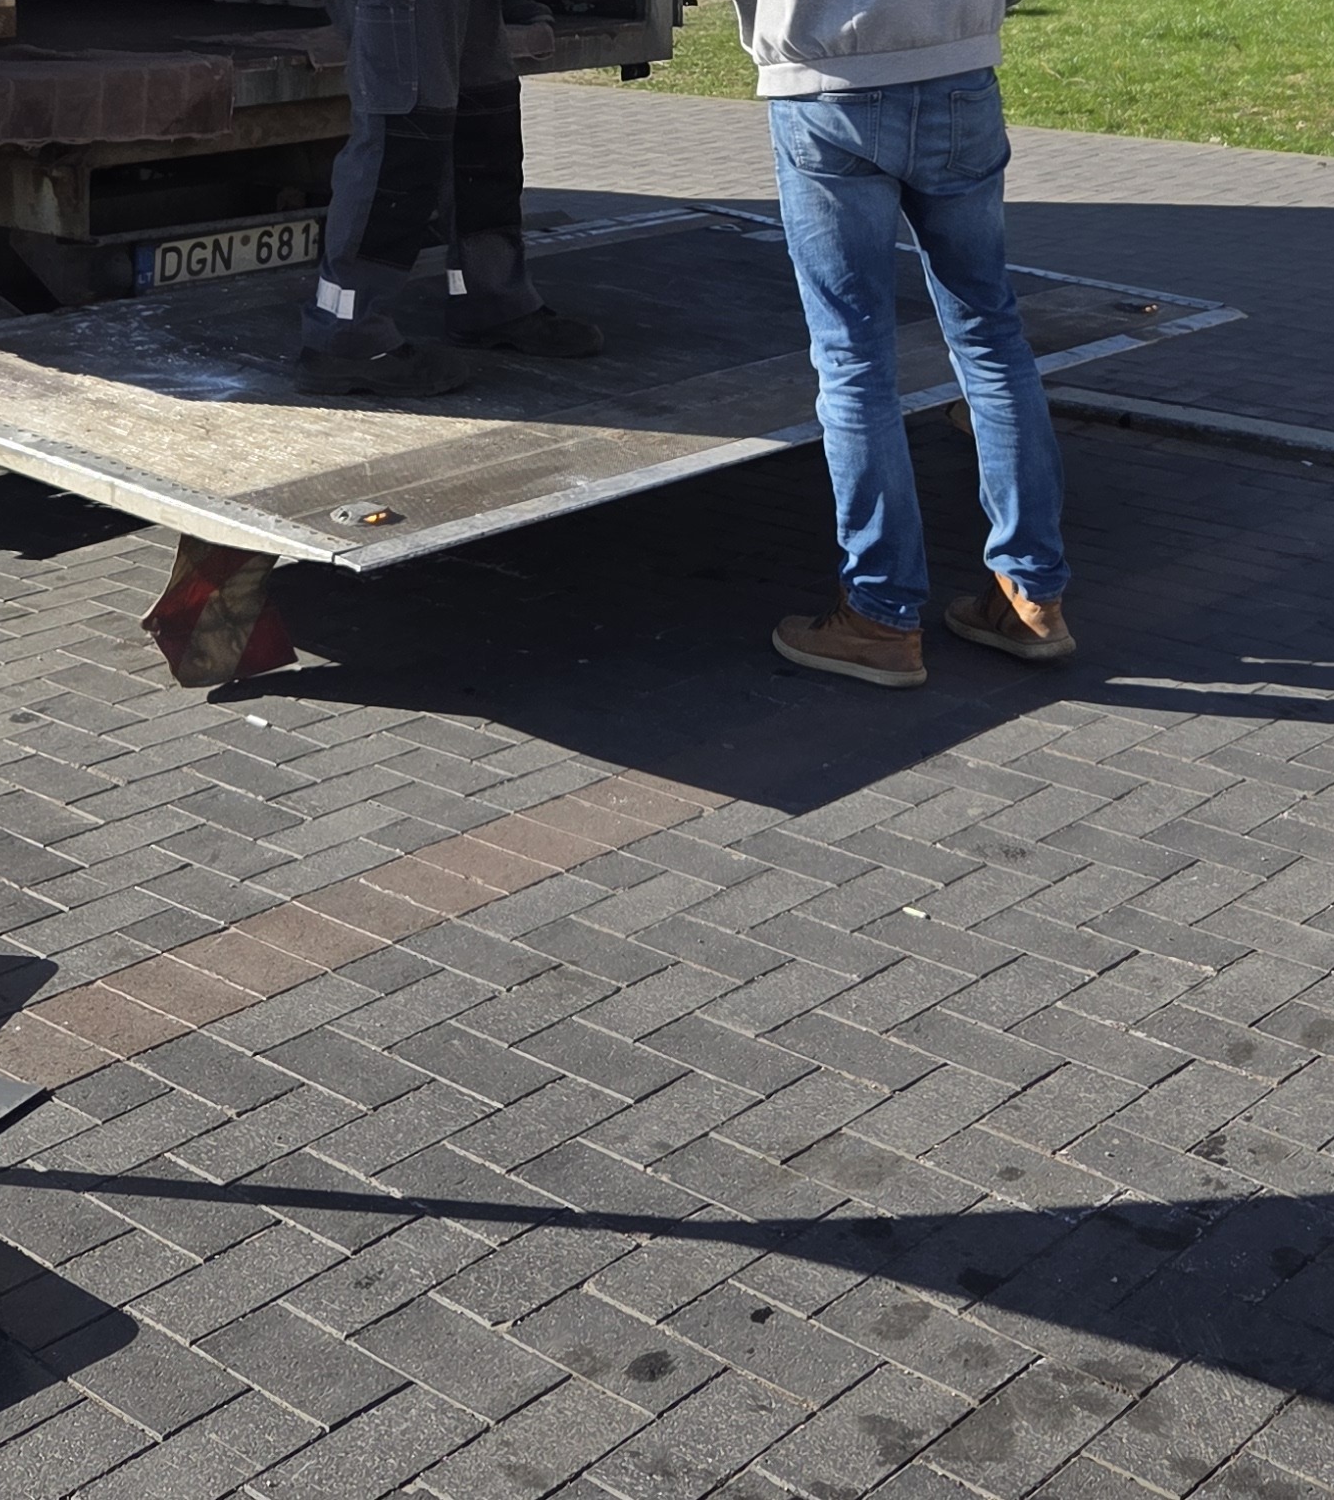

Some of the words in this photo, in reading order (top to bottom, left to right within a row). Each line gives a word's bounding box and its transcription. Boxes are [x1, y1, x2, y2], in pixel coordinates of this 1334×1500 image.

[159, 235, 234, 283] DGN
[255, 222, 312, 265] 681
[138, 271, 153, 284] LT
